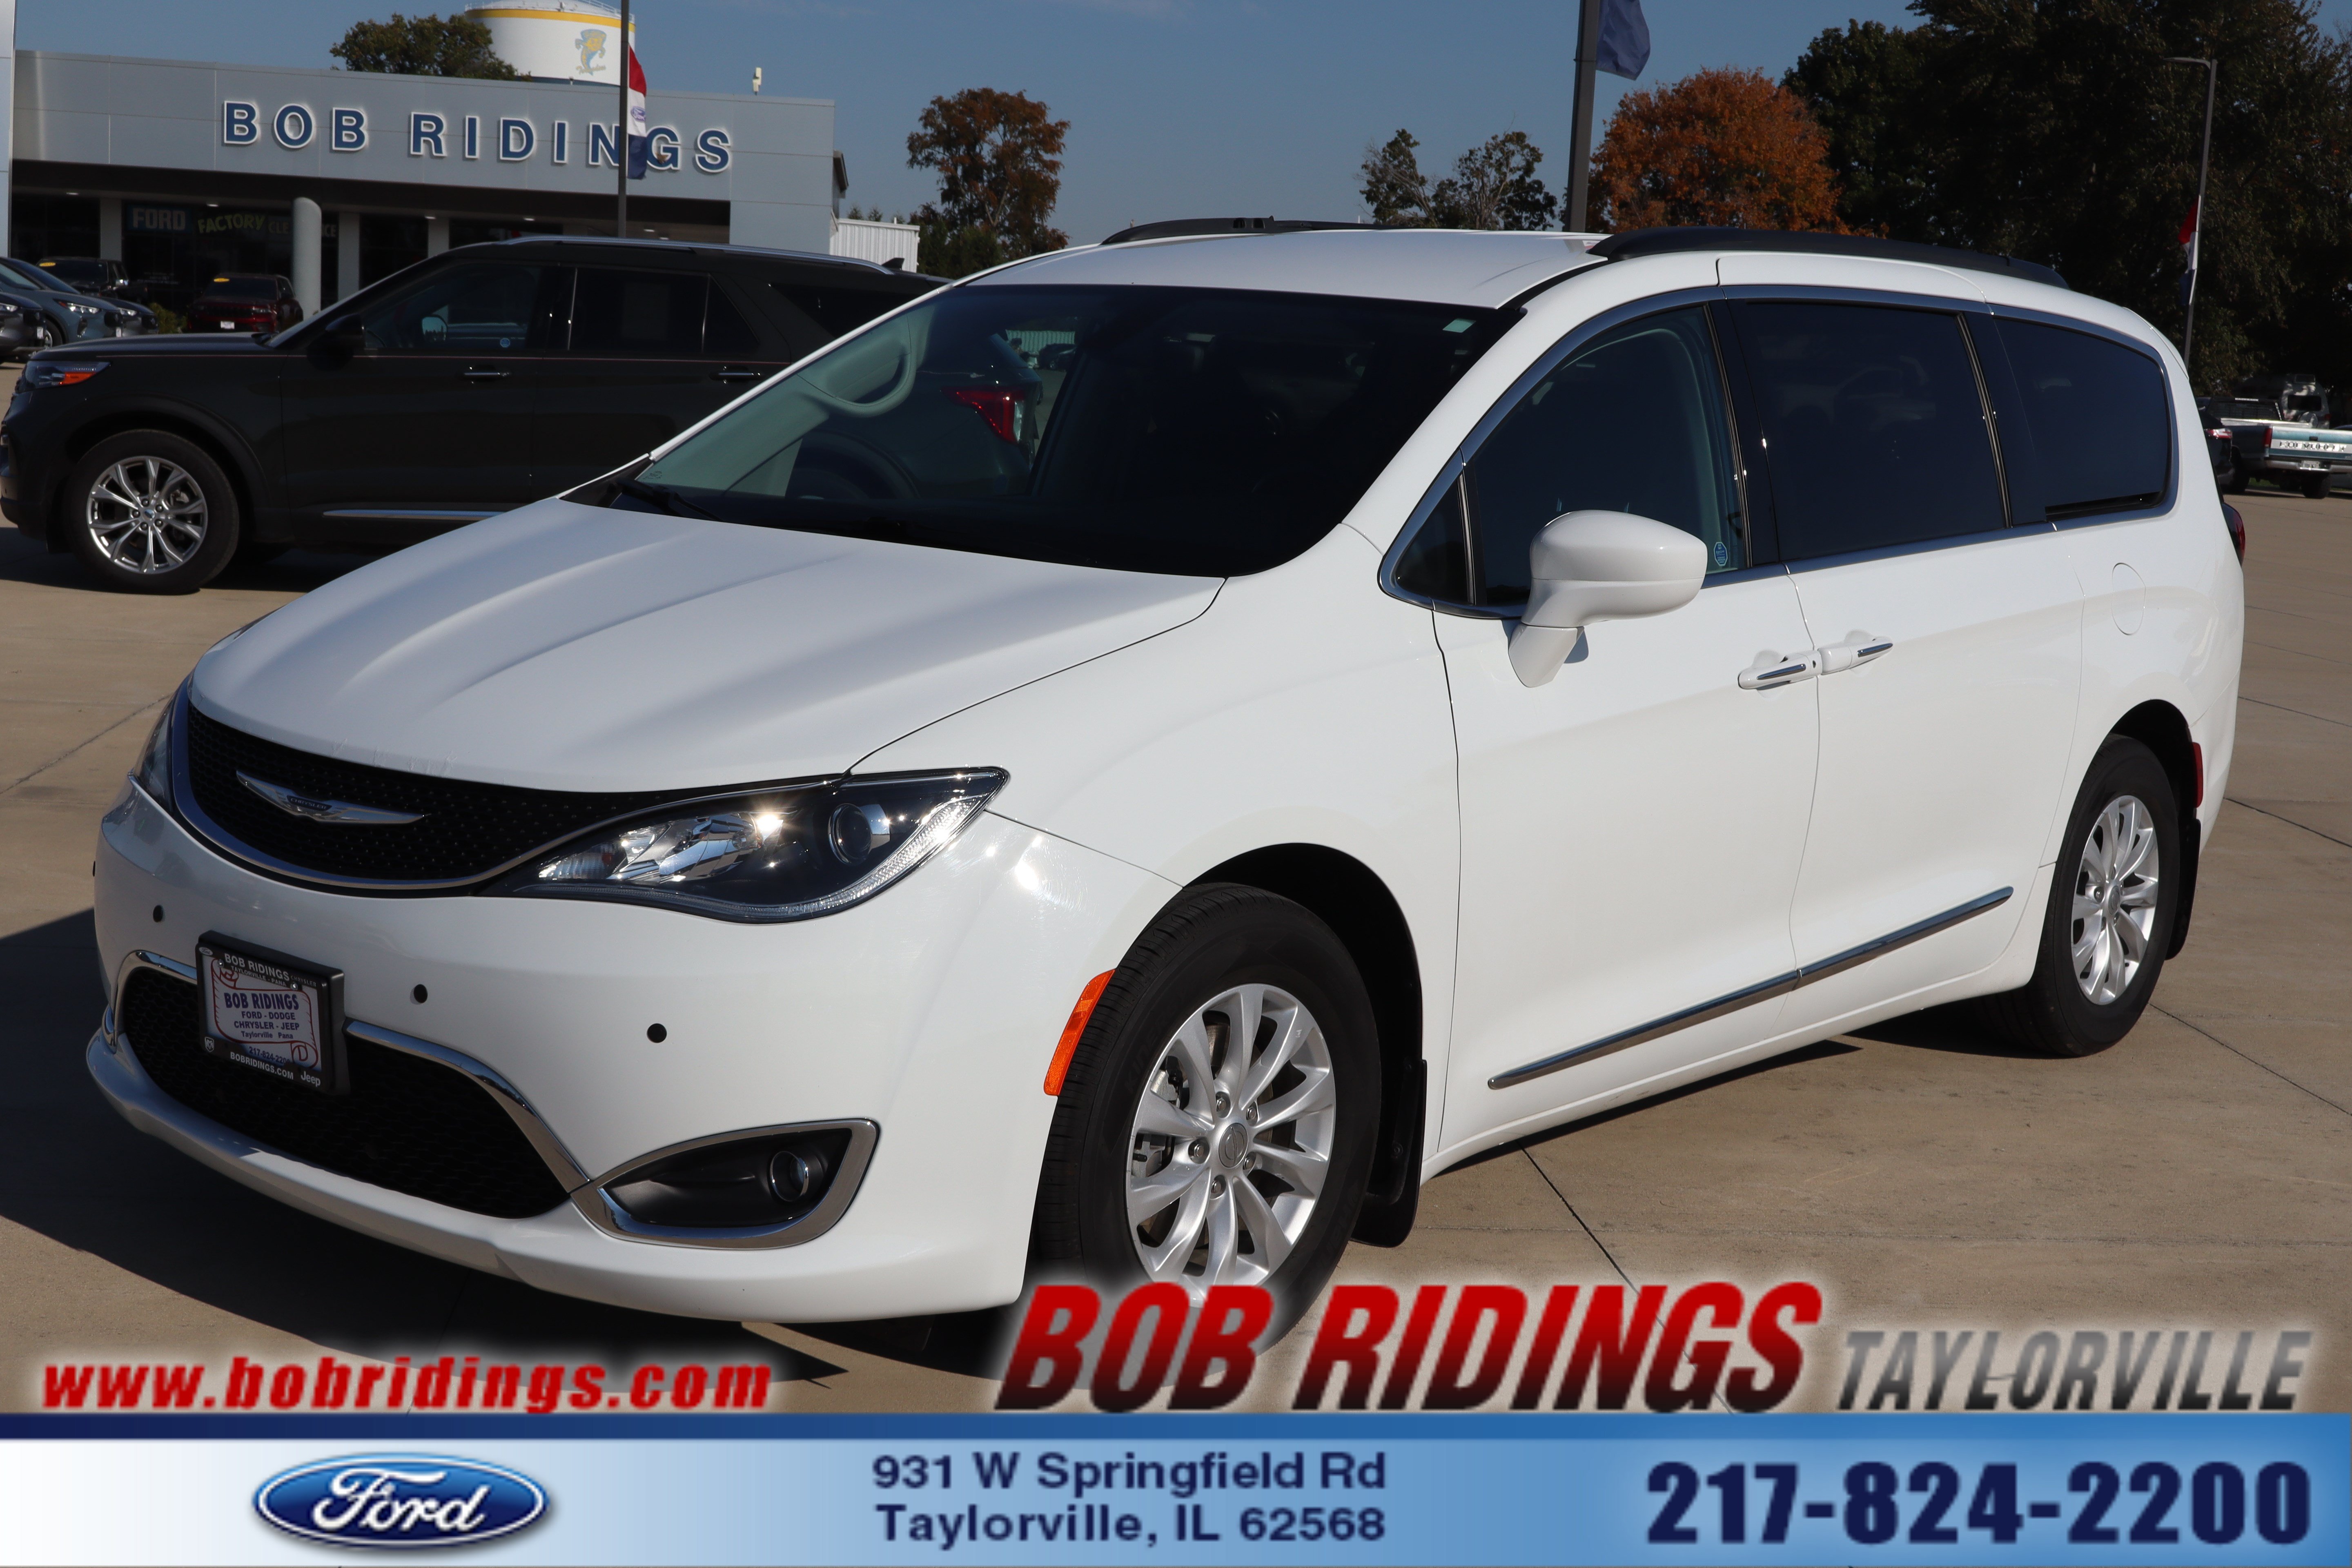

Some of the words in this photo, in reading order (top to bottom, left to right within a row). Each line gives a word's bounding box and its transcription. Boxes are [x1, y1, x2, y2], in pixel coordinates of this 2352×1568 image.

[224, 100, 366, 151] BOB
[410, 111, 732, 173] RIDINGS
[132, 207, 186, 231] FORD
[197, 212, 267, 234] FACTORY
[290, 797, 327, 809] CHRYSLER
[225, 953, 245, 968] BOB
[248, 960, 290, 981] RIDINGS
[231, 965, 266, 980] TAYLORVILLE
[271, 979, 287, 987] PANA
[290, 975, 316, 987] CHRYSLER
[224, 993, 249, 1009] BOB
[251, 993, 299, 1010] RIDINGS
[268, 1012, 296, 1020] DODGE
[234, 1021, 274, 1029] CHRYSLER
[230, 1051, 294, 1080] BOBRIDINGS.COM
[301, 1071, 321, 1087] Jeep
